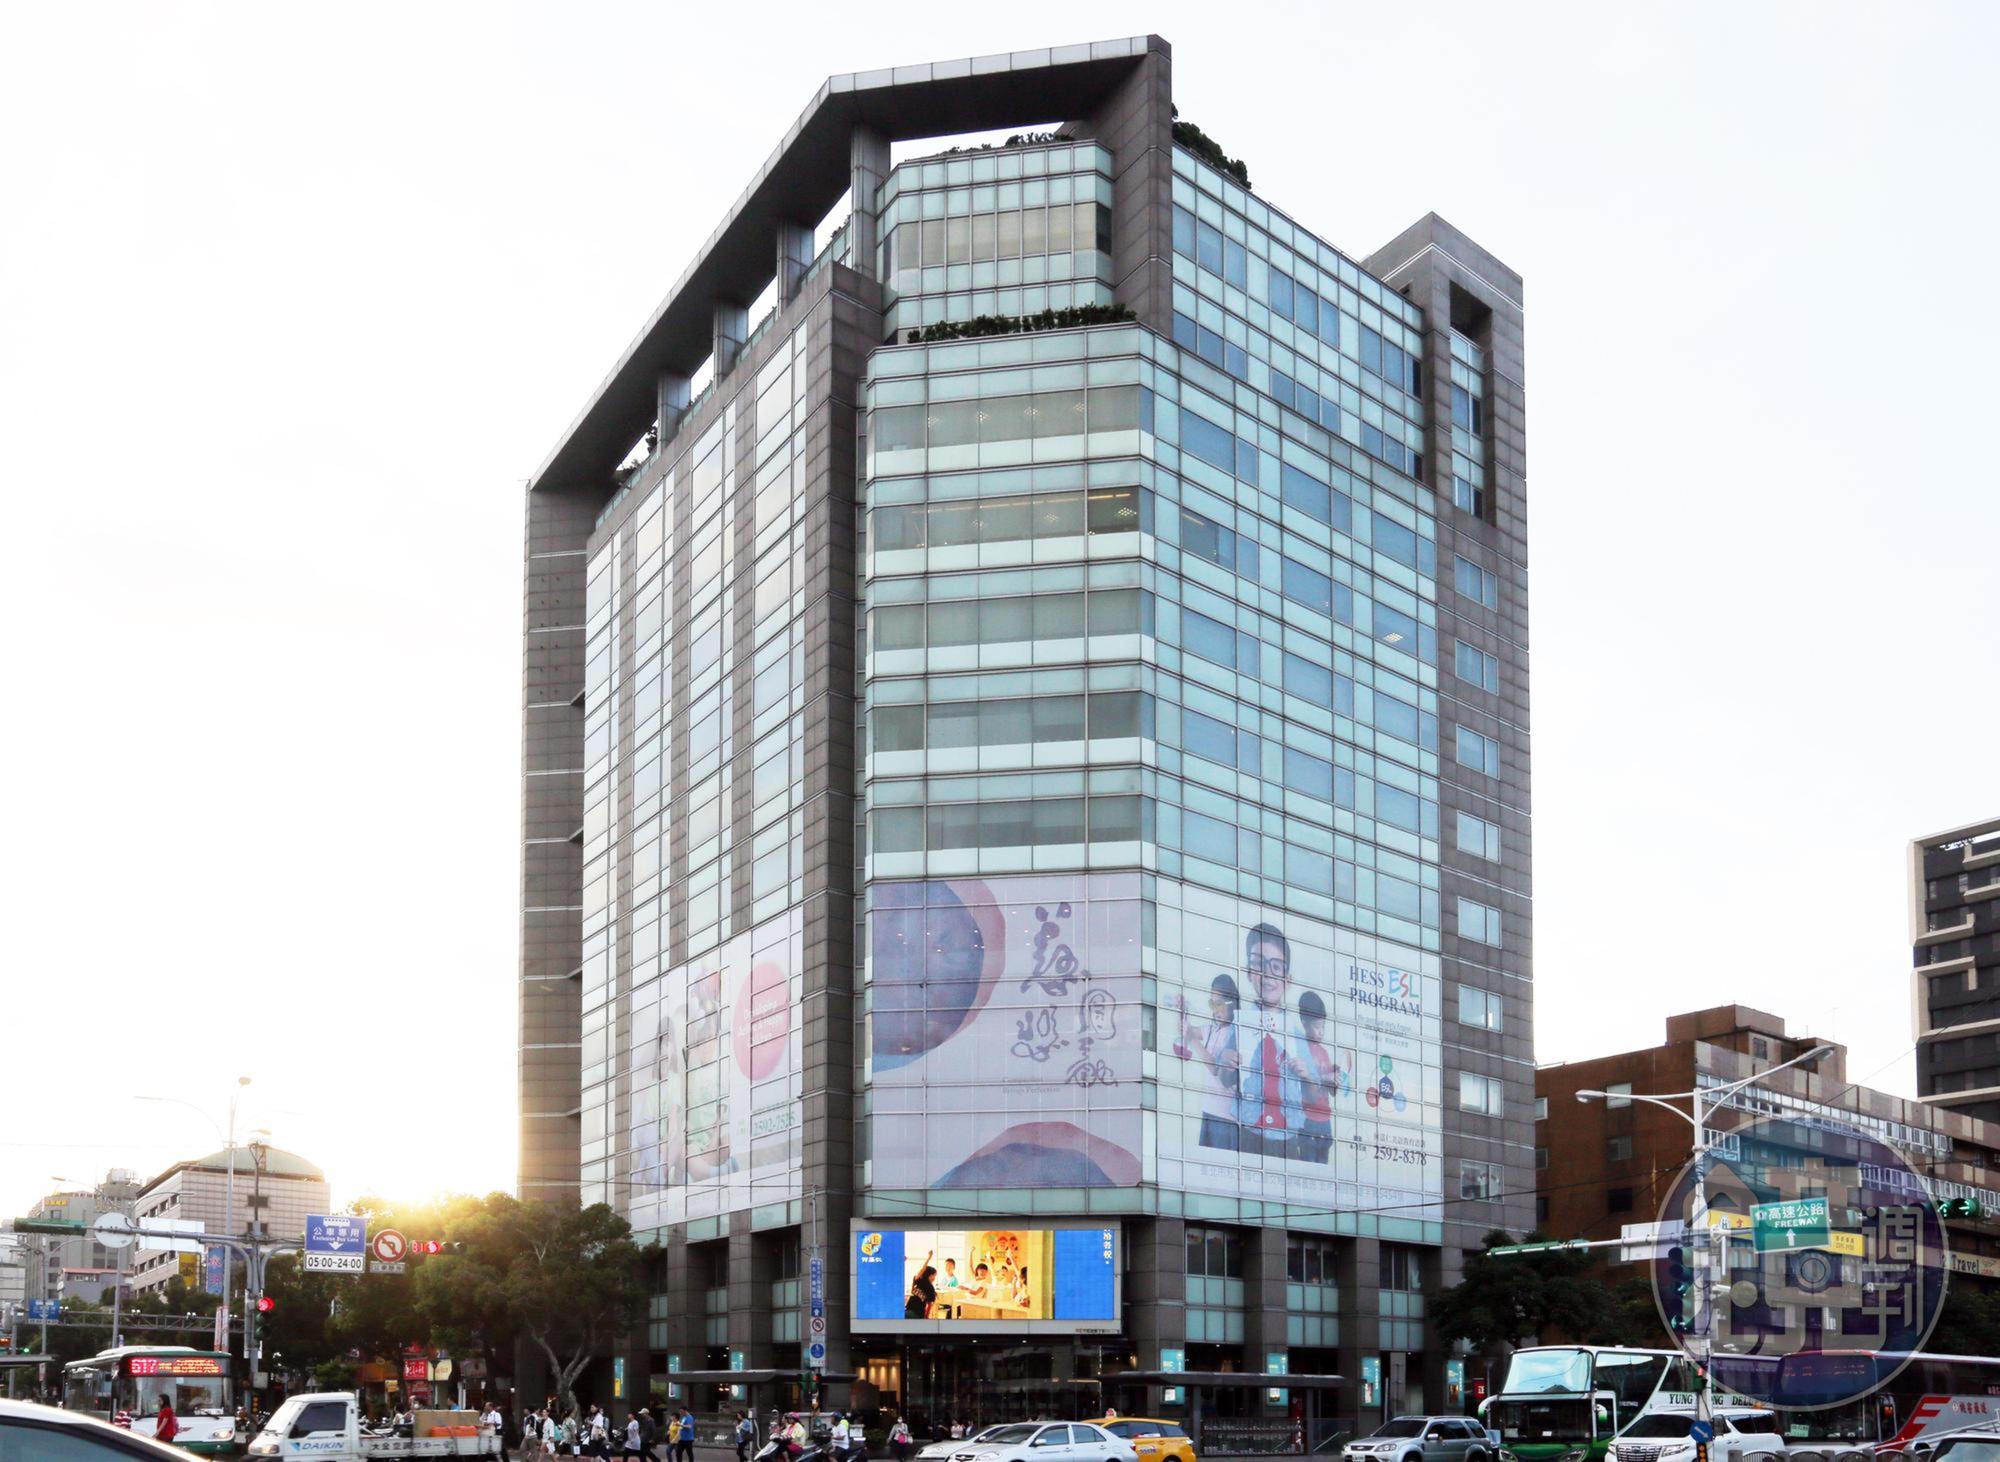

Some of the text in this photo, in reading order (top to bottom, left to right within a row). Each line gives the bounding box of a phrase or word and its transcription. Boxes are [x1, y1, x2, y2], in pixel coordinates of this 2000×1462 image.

[1350, 966, 1419, 998] HESS ESL
[1350, 988, 1420, 1018] PROGRAM
[1374, 1145, 1427, 1166] 2592-8378
[1768, 1203, 1825, 1221] 高速公路
[1774, 1217, 1819, 1228] FREEWAY
[313, 1227, 359, 1237] 公車專用
[1952, 1254, 1979, 1274] Travel
[131, 1359, 158, 1374] 617
[1669, 1394, 1693, 1405] YUNG
[302, 1441, 345, 1450] DAIKIN
